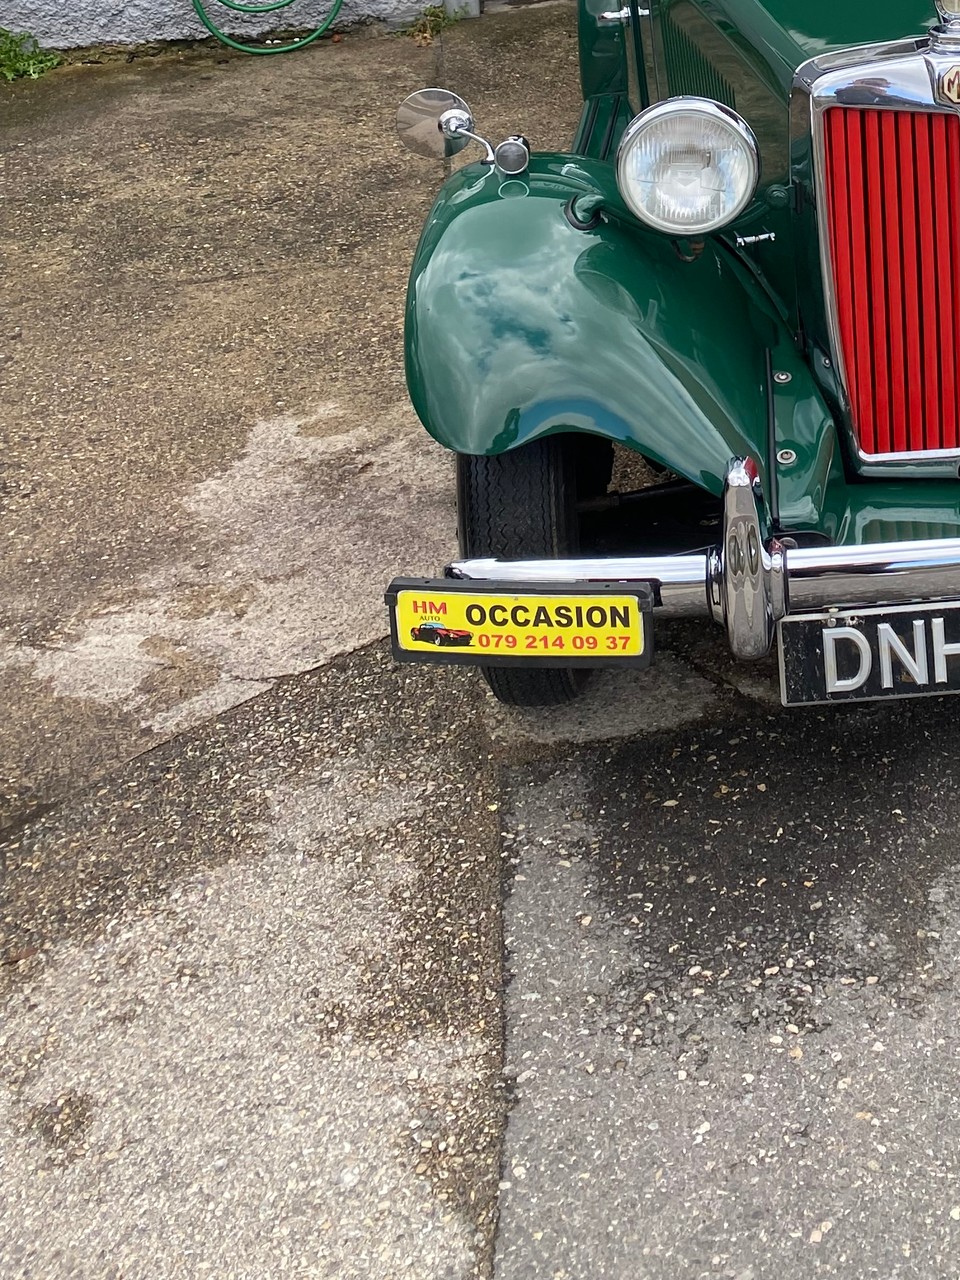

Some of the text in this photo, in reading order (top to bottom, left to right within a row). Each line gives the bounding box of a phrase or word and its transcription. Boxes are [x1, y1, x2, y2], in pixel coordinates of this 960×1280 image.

[412, 600, 447, 615] HM
[465, 604, 631, 628] OCCASION
[478, 634, 631, 650] 079 214 09 37
